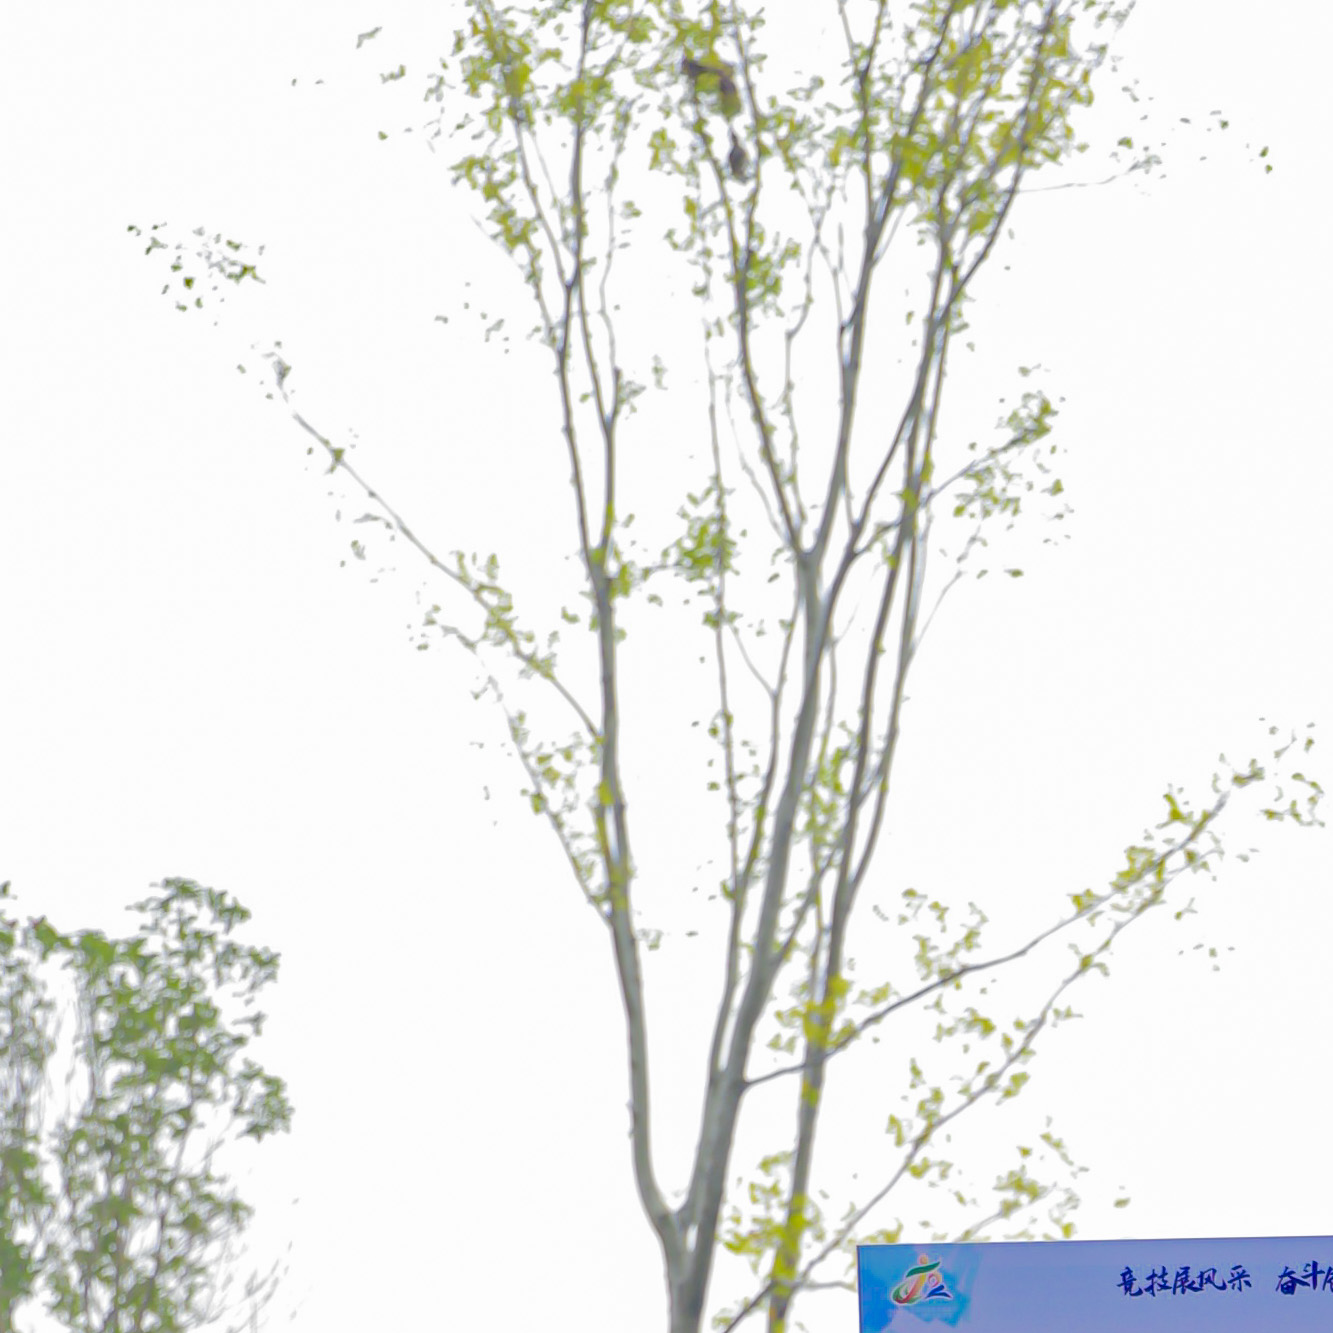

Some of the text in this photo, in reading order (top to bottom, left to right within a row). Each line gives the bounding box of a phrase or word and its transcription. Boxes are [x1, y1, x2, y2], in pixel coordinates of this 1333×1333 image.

[1116, 1265, 1252, 1297] 竞技展风采
